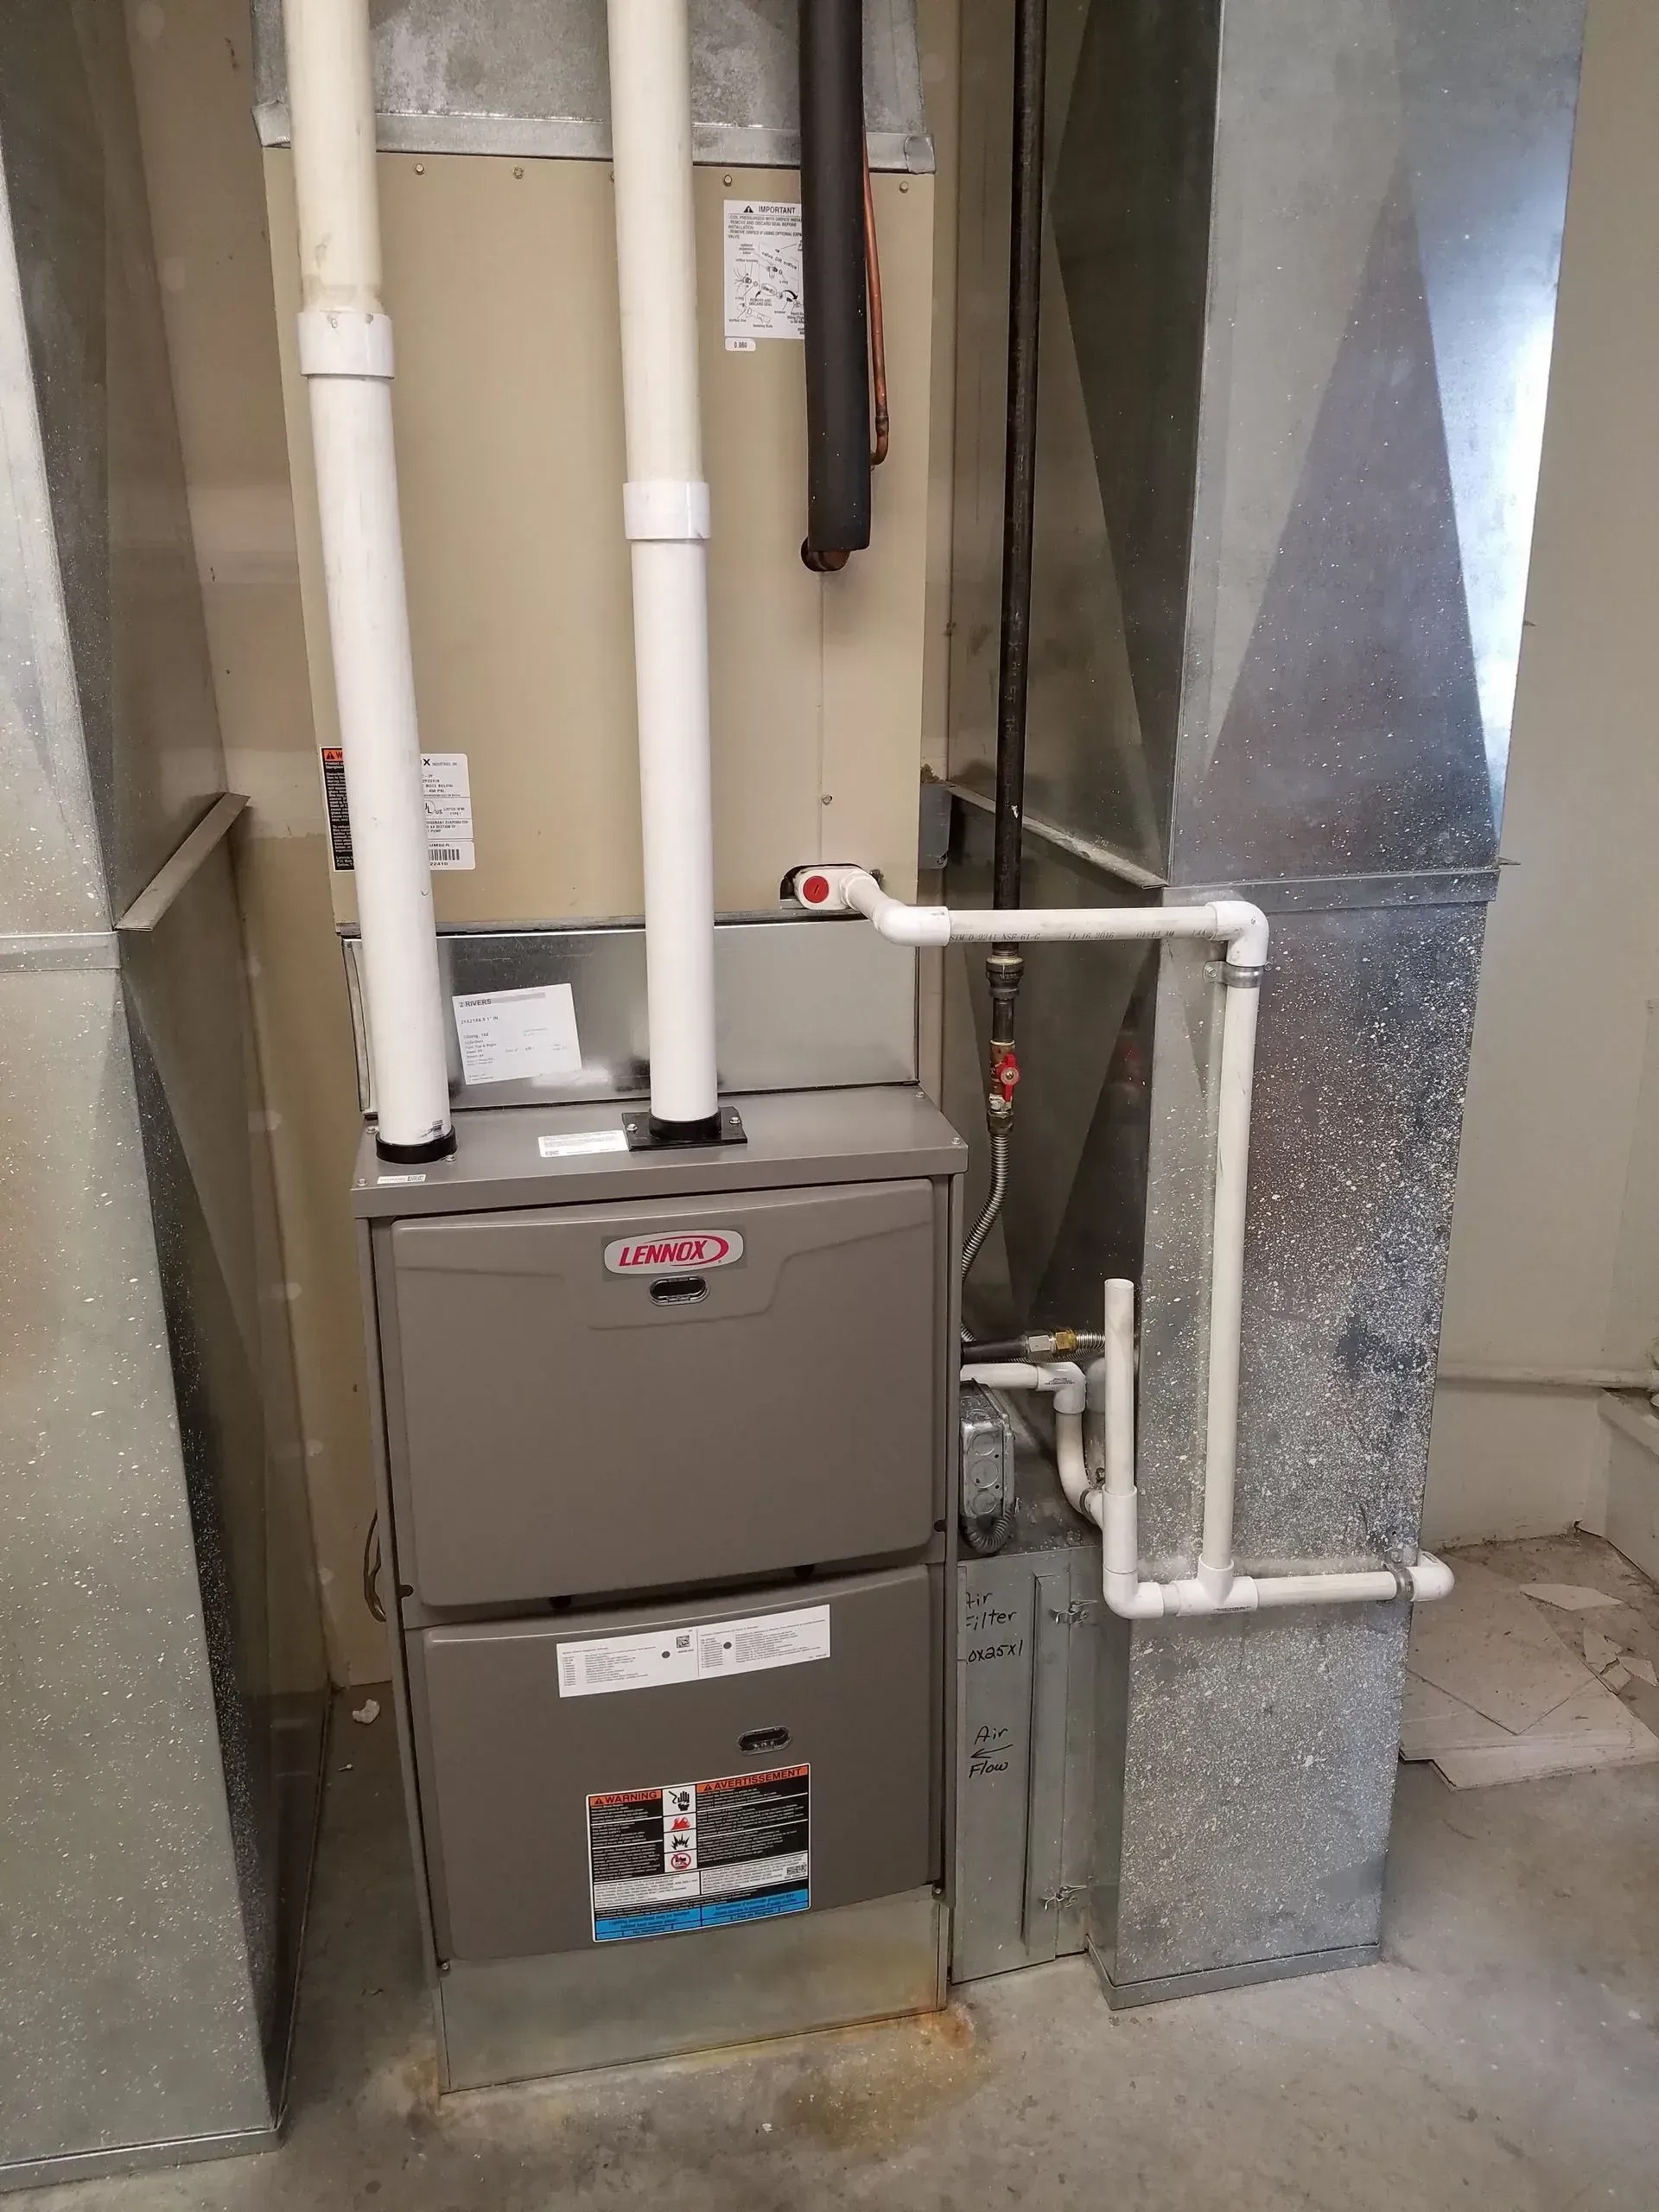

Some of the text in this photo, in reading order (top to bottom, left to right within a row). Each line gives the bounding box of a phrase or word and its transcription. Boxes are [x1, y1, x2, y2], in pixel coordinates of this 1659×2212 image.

[758, 205, 796, 214] IMPORTANT
[465, 998, 492, 1007] RIVERS
[619, 1239, 708, 1267] LENNOX
[974, 1725, 1009, 1745] Air
[968, 1759, 1009, 1778] Flow
[714, 1768, 802, 1790] AVERTISSEMENT
[605, 1791, 658, 1804] WARNING
